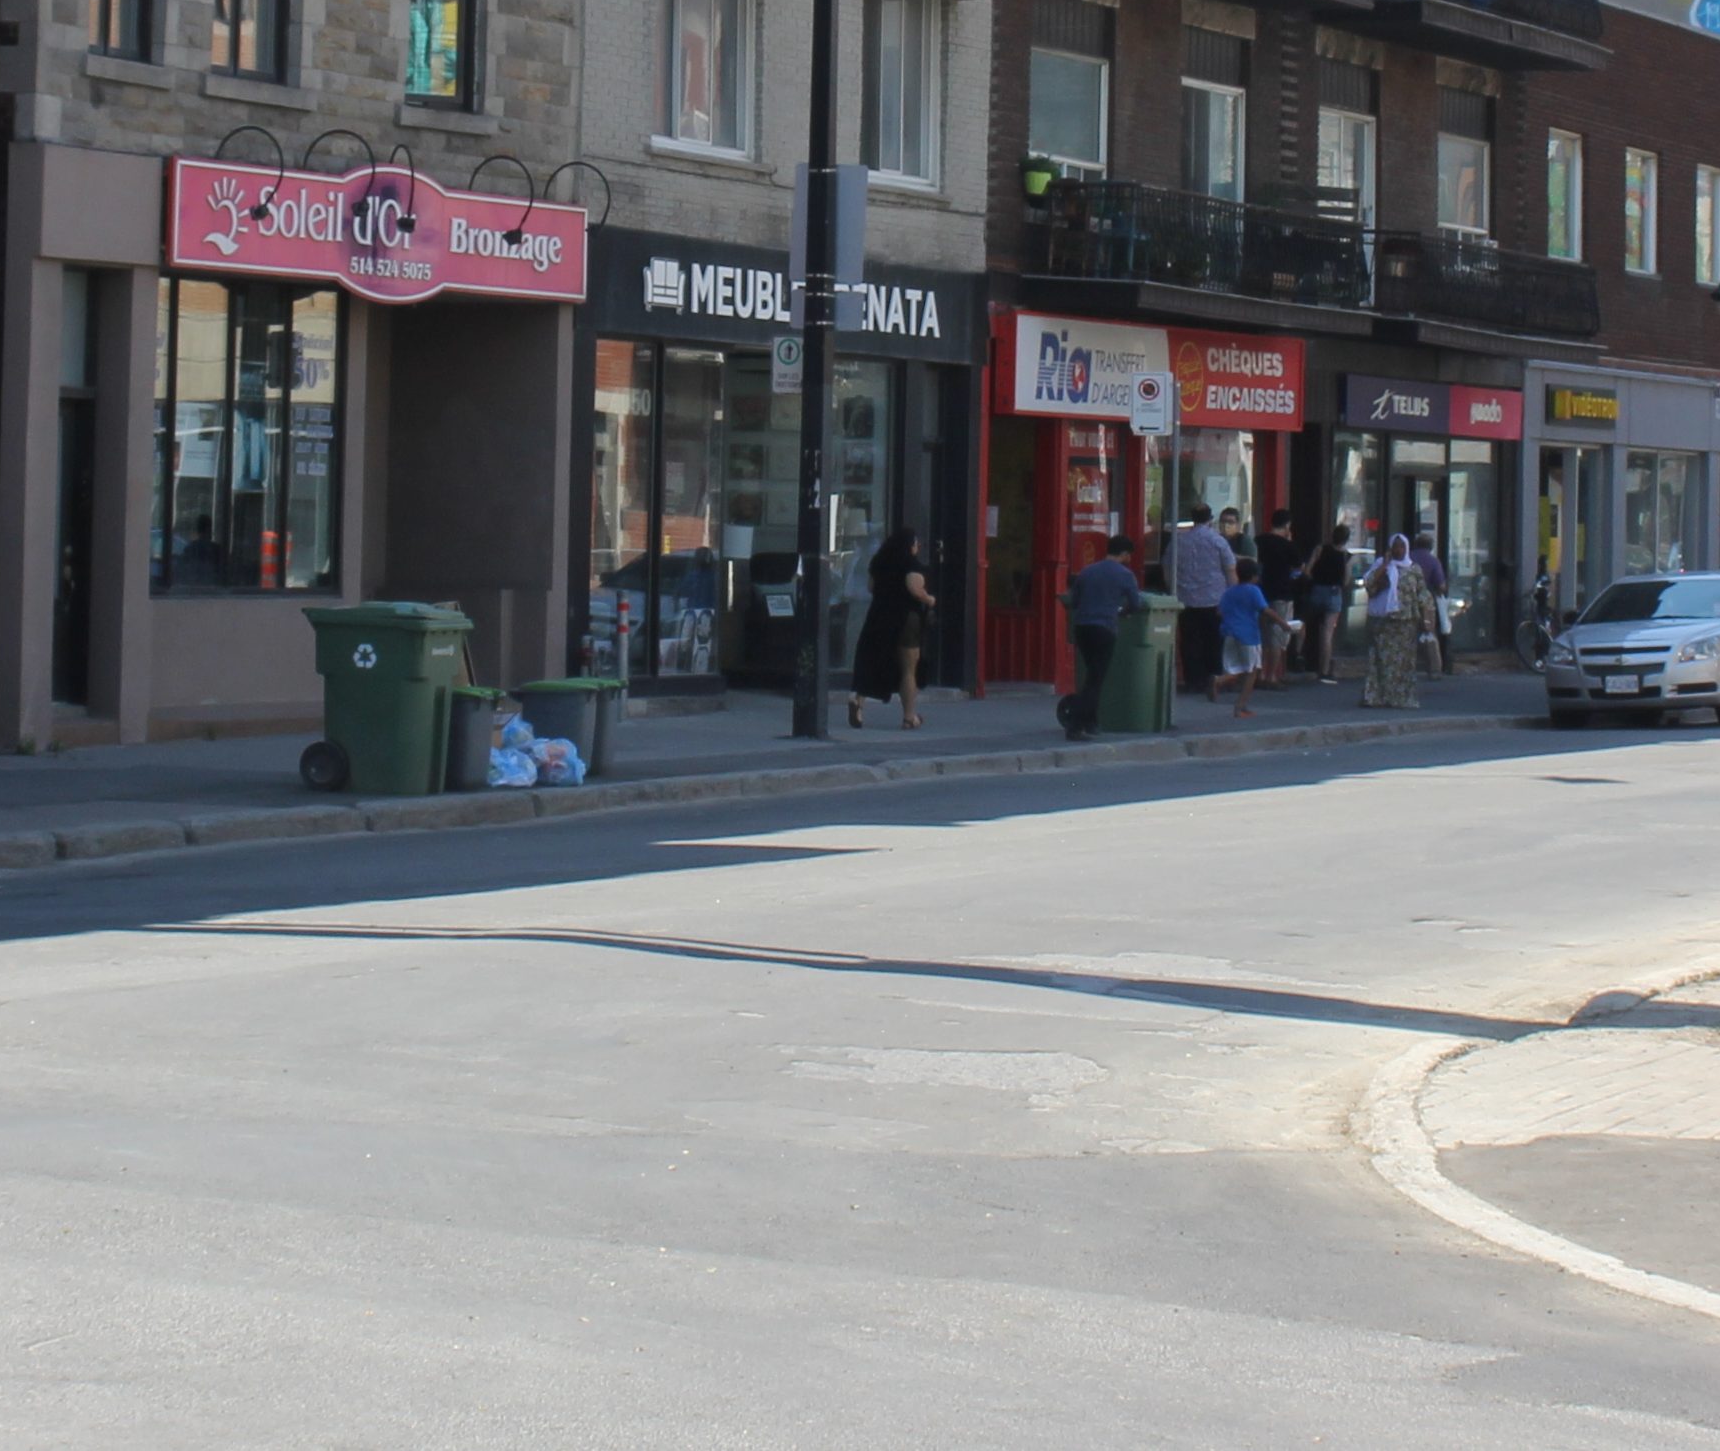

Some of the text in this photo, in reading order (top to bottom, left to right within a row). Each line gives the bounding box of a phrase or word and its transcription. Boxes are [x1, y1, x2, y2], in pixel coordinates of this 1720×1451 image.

[258, 186, 562, 272] Soleil d'Or Bronzage
[350, 256, 431, 281] 514 524 5075
[690, 263, 807, 323] MEUBL
[1035, 329, 1092, 404] Ria
[1206, 343, 1283, 377] CHÈQUES
[1091, 381, 1130, 406] D'ARGE
[1206, 384, 1294, 415] ENCAISSÉS
[1392, 394, 1429, 417] TELUS
